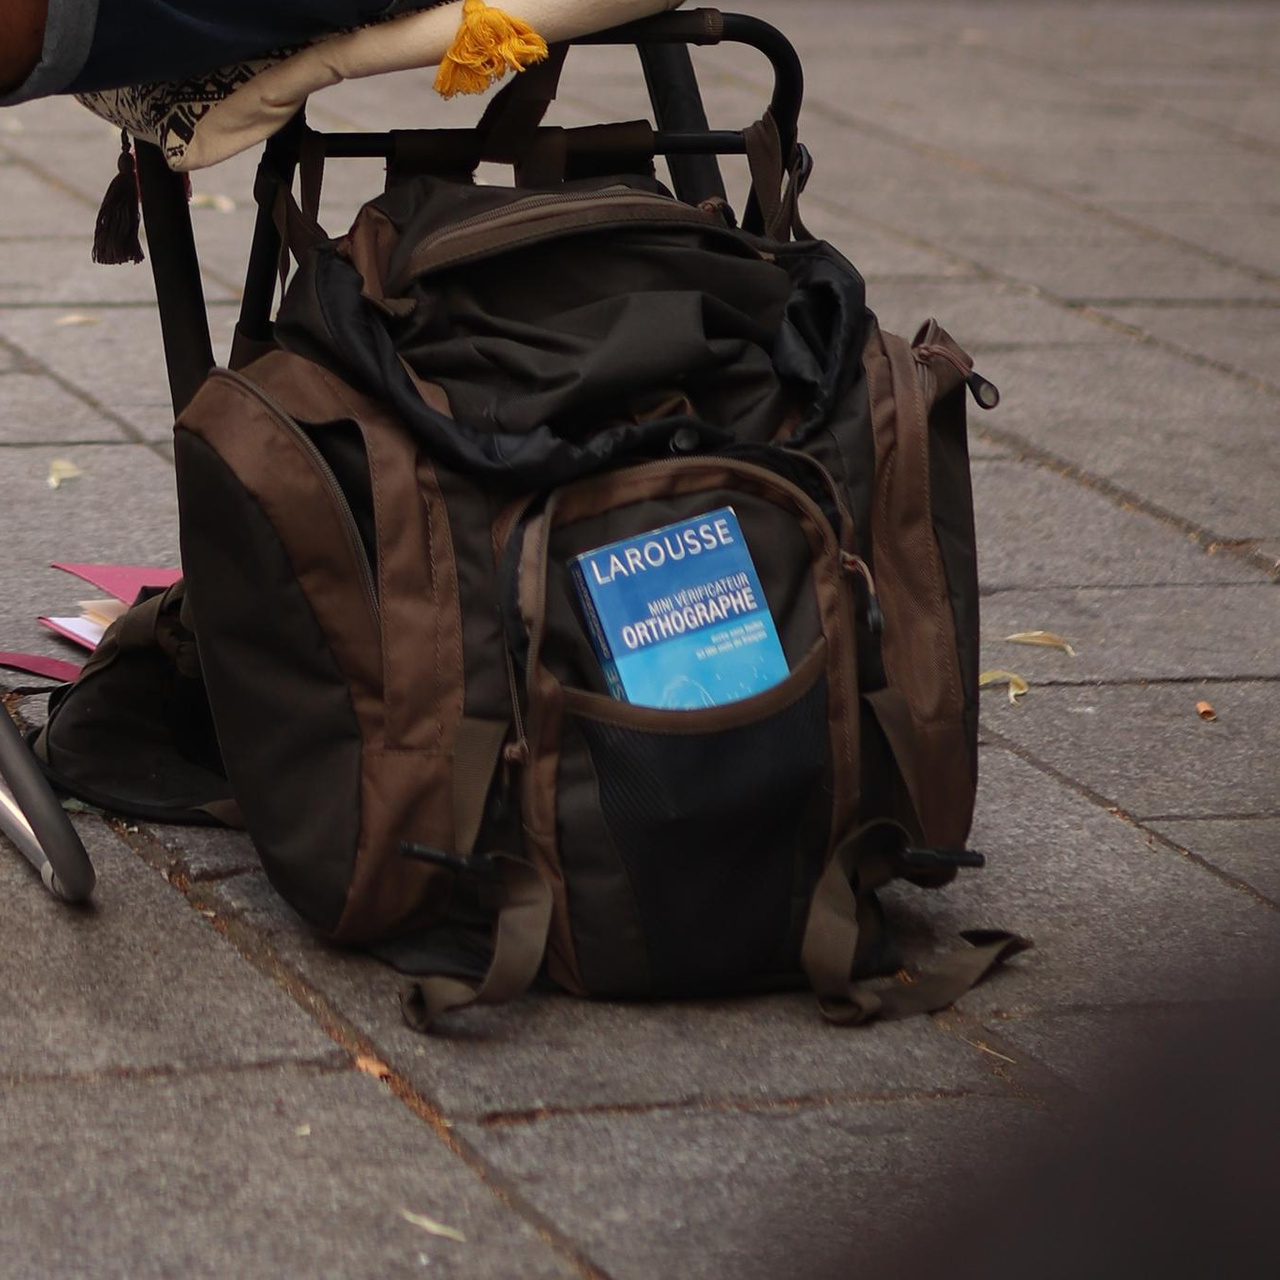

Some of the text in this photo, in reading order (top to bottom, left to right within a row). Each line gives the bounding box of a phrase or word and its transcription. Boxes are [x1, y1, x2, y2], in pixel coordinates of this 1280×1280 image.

[590, 518, 735, 586] LAROUSSE
[621, 587, 759, 651] ORTHOGRAPHE
[647, 572, 751, 617] MINI VÉRIFICATEUR
